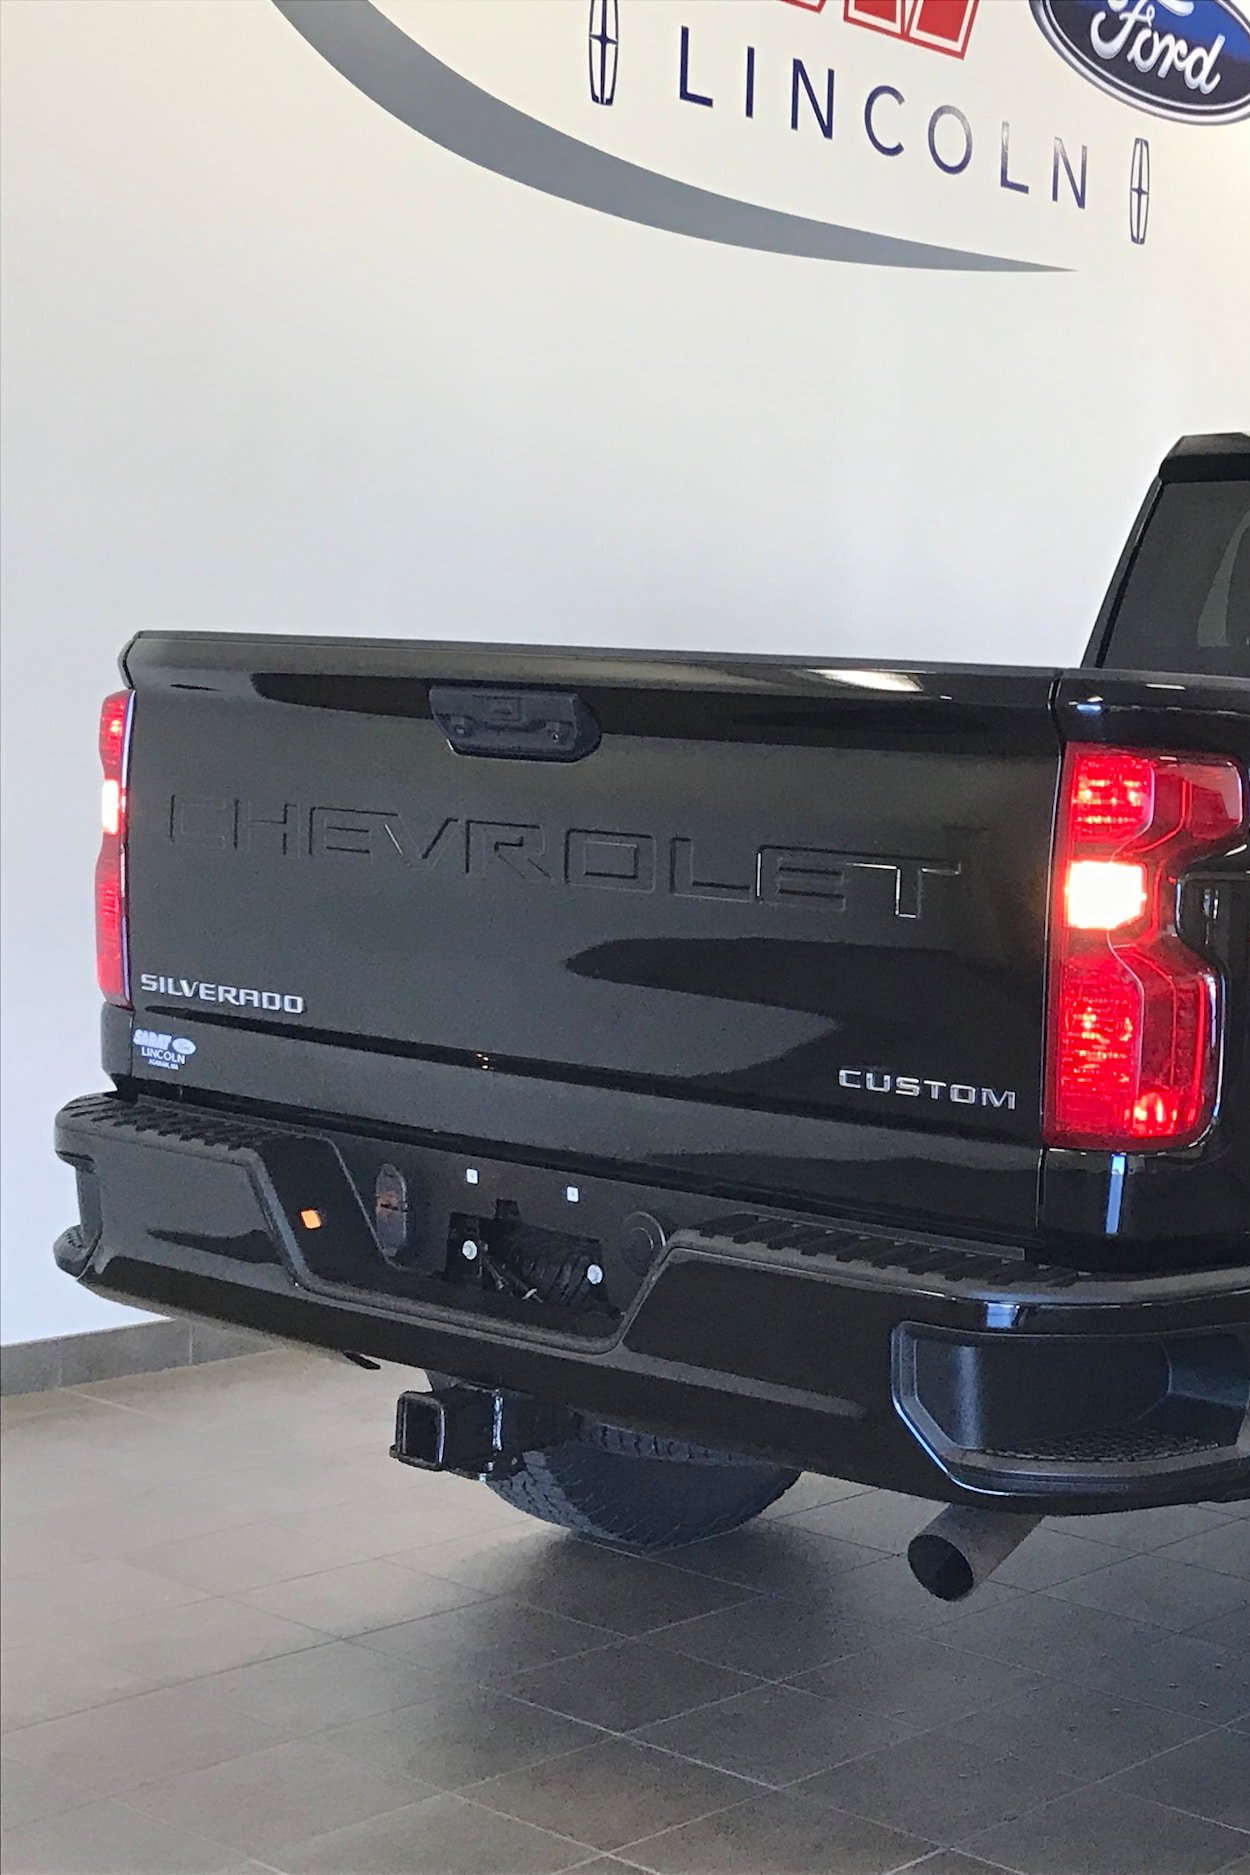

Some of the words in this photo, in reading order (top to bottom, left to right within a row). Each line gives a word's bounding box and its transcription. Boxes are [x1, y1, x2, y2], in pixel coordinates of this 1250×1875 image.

[1090, 0, 1226, 95] Ford
[678, 25, 1089, 210] LINCOLN
[170, 794, 962, 919] CHEVROLET
[140, 973, 305, 1014] SILVERADO
[141, 1046, 186, 1065] LINCOLN
[838, 1069, 1016, 1110] CUSTOM
